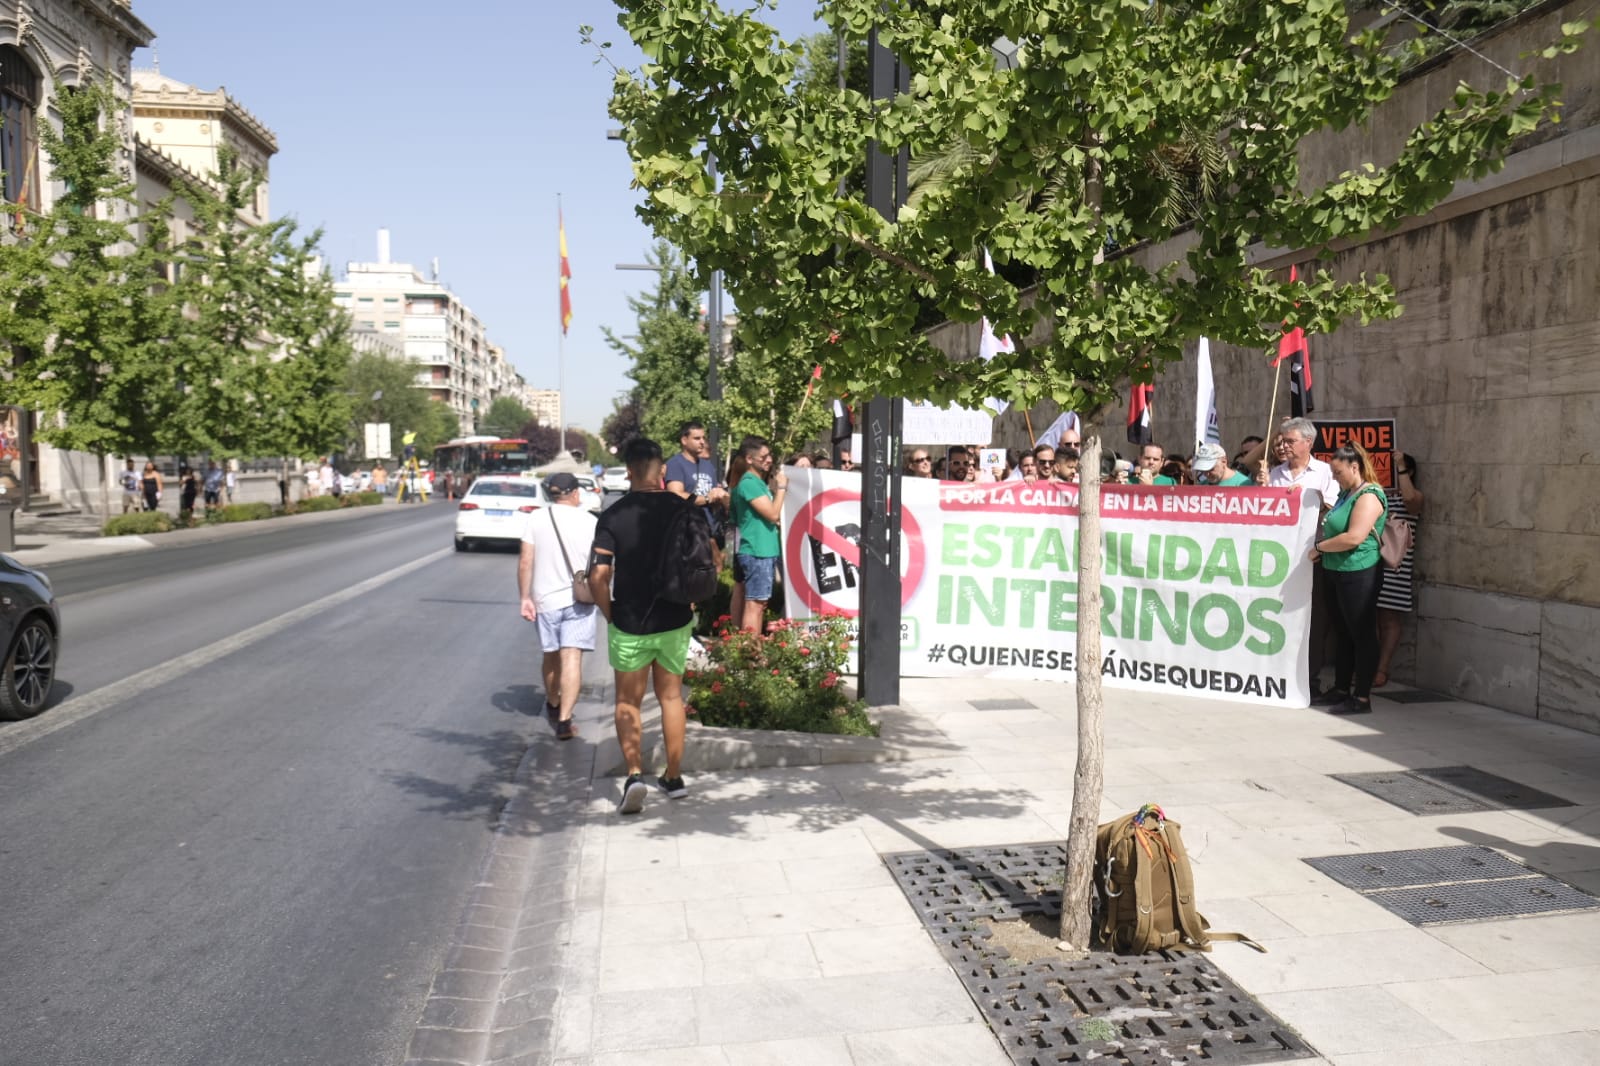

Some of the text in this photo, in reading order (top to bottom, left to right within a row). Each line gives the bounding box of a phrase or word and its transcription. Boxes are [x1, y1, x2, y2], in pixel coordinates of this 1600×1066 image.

[1321, 426, 1391, 449] VENDE
[945, 489, 1291, 517] POR LA CALID EN LA ENSEÑANZA
[941, 523, 1290, 588] ESTAILIDAD
[927, 643, 1287, 700] #QUIENESEÁNSEQUEDAN
